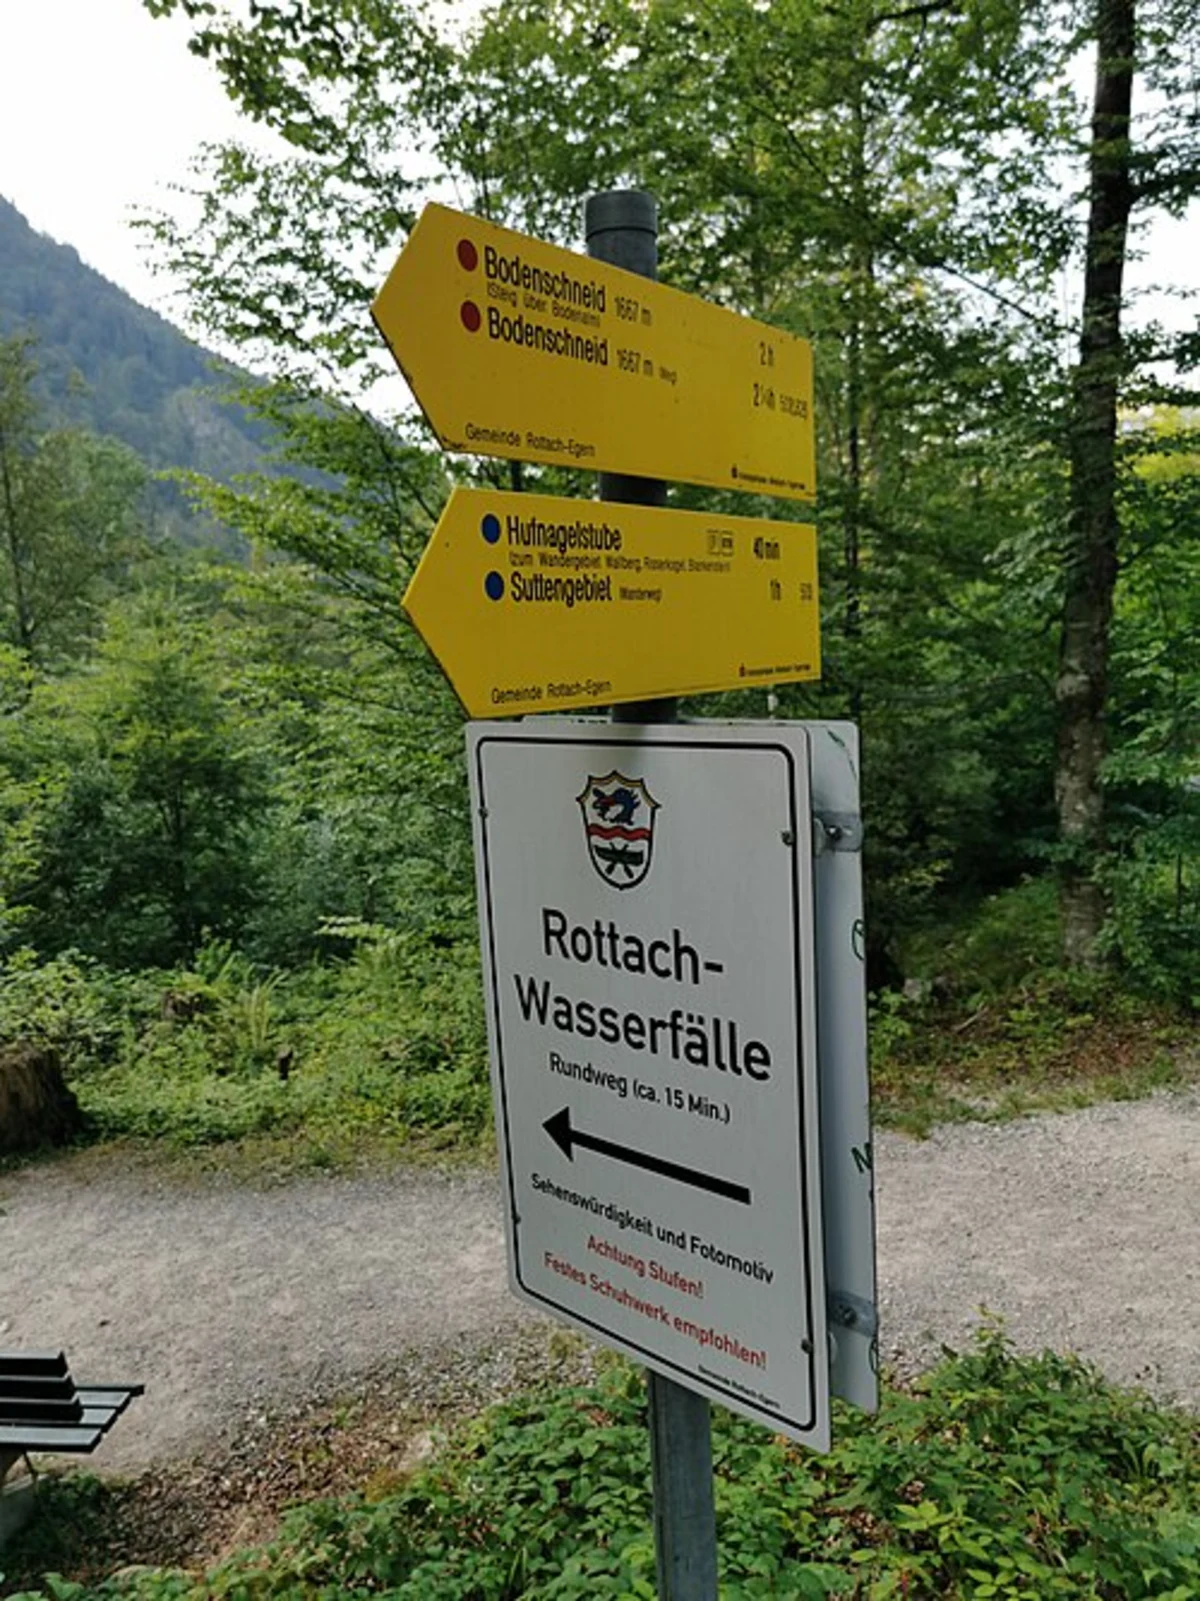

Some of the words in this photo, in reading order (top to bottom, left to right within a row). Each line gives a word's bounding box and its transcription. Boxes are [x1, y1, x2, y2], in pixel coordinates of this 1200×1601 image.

[485, 246, 606, 312] Bodenschneid
[614, 297, 639, 322] 1667
[488, 307, 608, 365] Bodenschneid
[616, 349, 641, 375] 1667
[465, 422, 521, 447] Gemeinde
[526, 432, 595, 458] Rottach-Egern
[507, 515, 622, 553] Hufnagelstube
[511, 570, 613, 607] Suttengebiet
[491, 685, 542, 704] Gemeinde
[547, 679, 612, 698] Rottach-Egern
[542, 907, 724, 985] Rottach-
[514, 973, 771, 1081] Wasserfälle
[550, 1052, 628, 1098] Rundweg
[633, 1079, 661, 1104] (ca.
[665, 1087, 684, 1109] 15
[689, 1093, 731, 1124] Min.)
[531, 1173, 653, 1237] Sehenswürdigkeit
[656, 1226, 686, 1250] und
[690, 1236, 774, 1285] Fotomotiv
[587, 1235, 646, 1278] Achtung
[649, 1261, 704, 1299] Stufen!
[544, 1252, 587, 1287] Festes
[589, 1274, 670, 1326] Schuhwerk
[673, 1317, 767, 1370] empfohlen!
